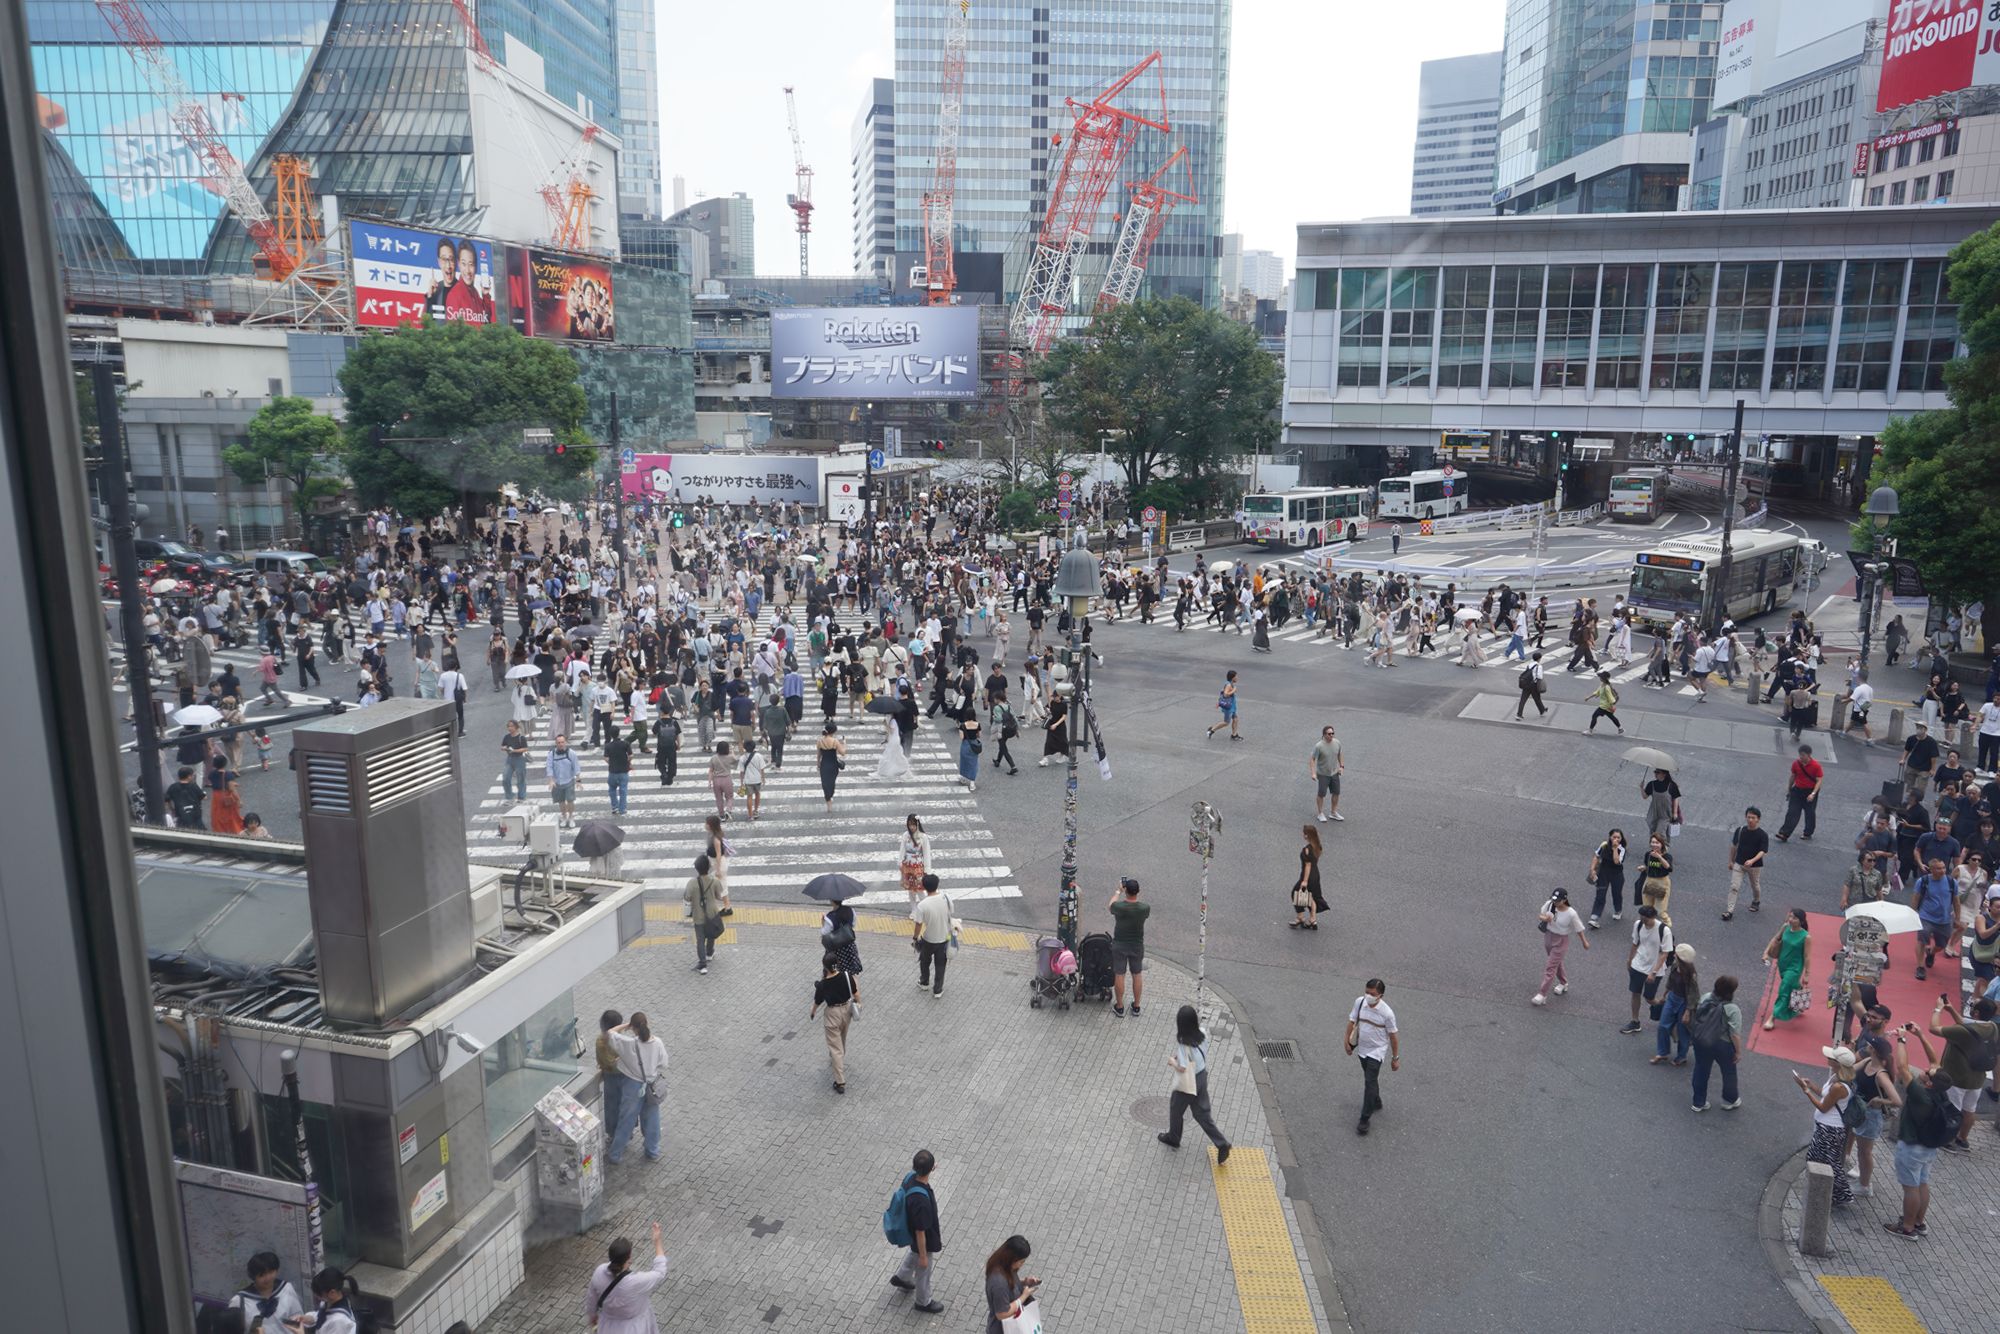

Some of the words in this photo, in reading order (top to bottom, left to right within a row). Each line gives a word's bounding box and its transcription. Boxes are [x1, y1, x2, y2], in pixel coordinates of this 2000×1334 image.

[1890, 0, 1972, 33] カラ
[1723, 18, 1754, 46] 広告募集
[1887, 8, 1978, 60] JOYSOUND
[1878, 134, 1905, 149] カラオケ
[1906, 123, 1942, 142] JOYSOUND
[380, 237, 421, 256] オトク
[368, 268, 422, 287] オドロク
[361, 298, 425, 318] ペイトク
[446, 306, 489, 323] SoftBank
[823, 316, 921, 344] Rakuten
[782, 353, 968, 385] プラチナバンド
[680, 473, 812, 490] つながりやすさも最強へ。
